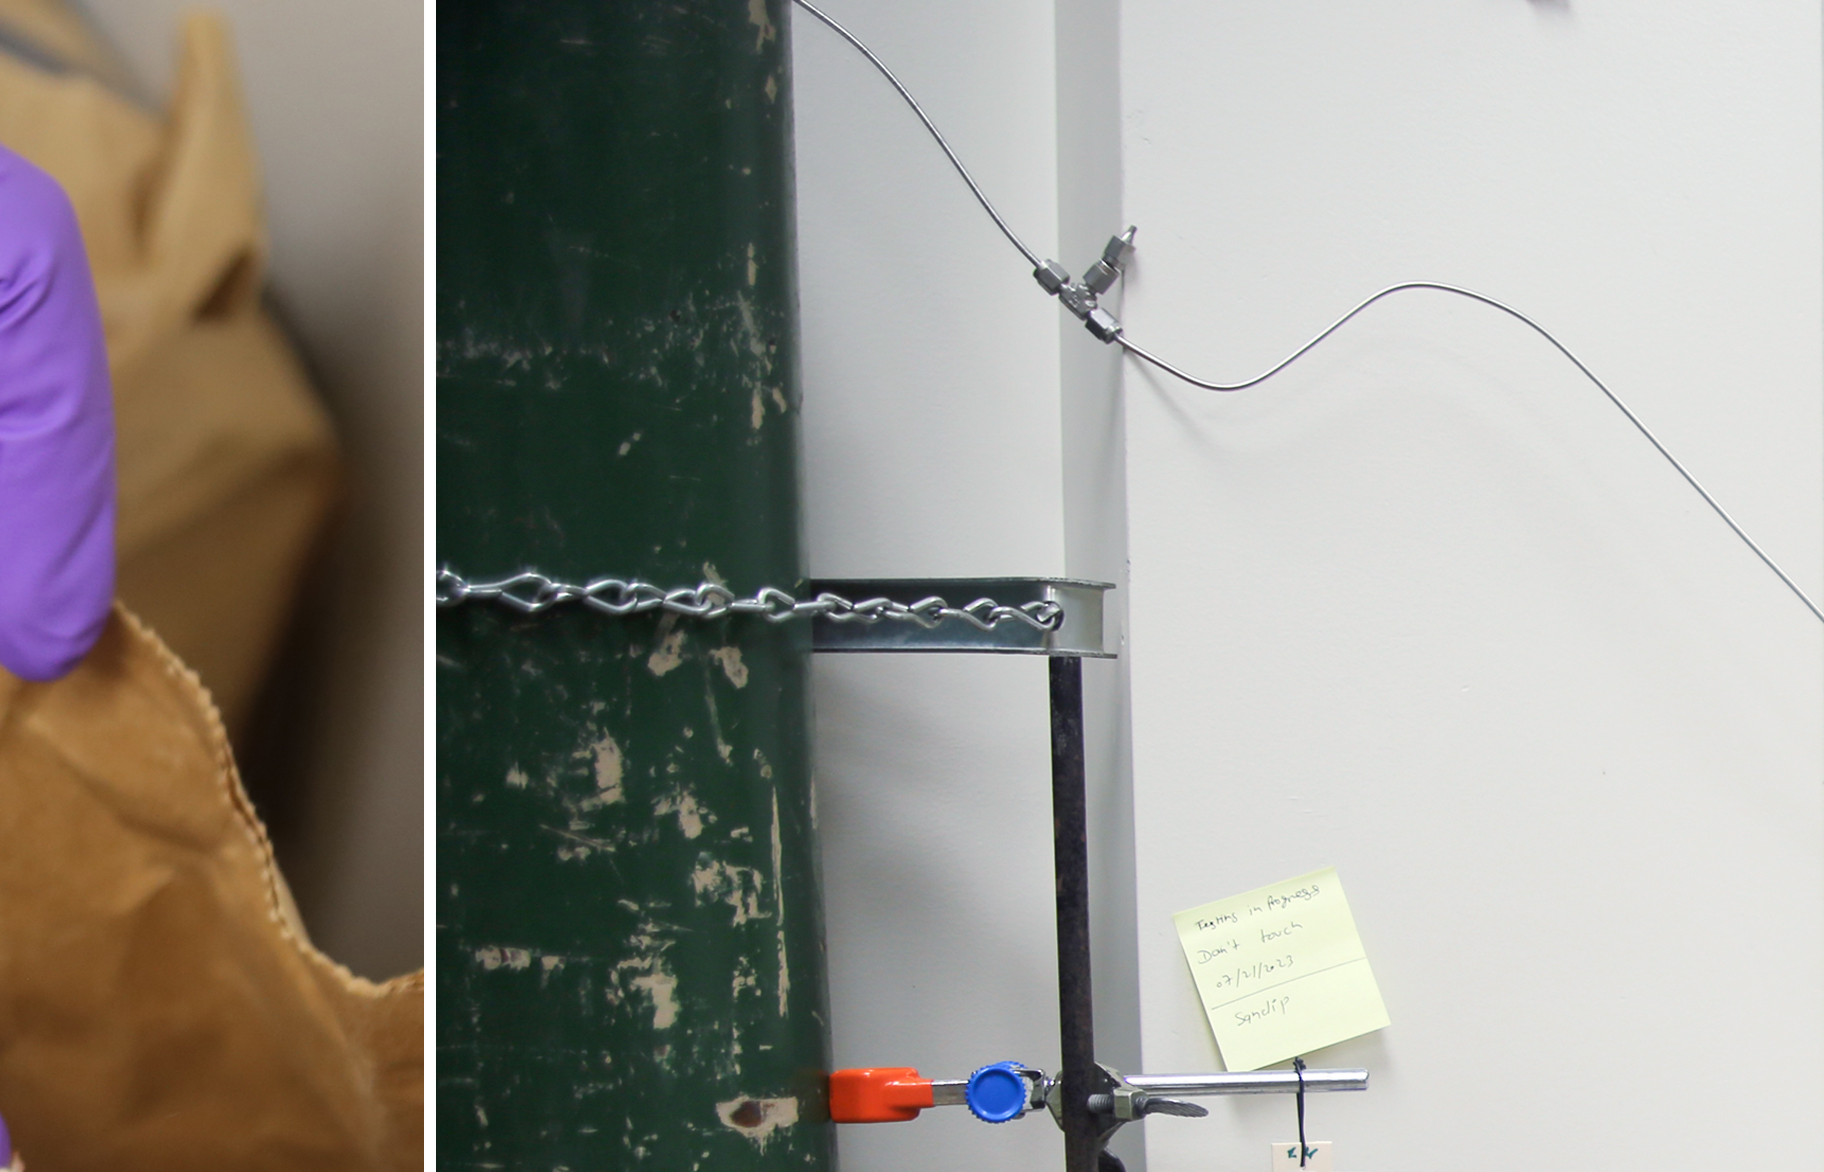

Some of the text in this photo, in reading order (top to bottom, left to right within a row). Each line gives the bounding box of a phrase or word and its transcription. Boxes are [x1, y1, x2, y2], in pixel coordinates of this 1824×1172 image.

[1247, 904, 1263, 916] in
[1260, 921, 1303, 943] touch
[1216, 954, 1294, 988] 07/21/2023
[1234, 996, 1290, 1026] Sandip
